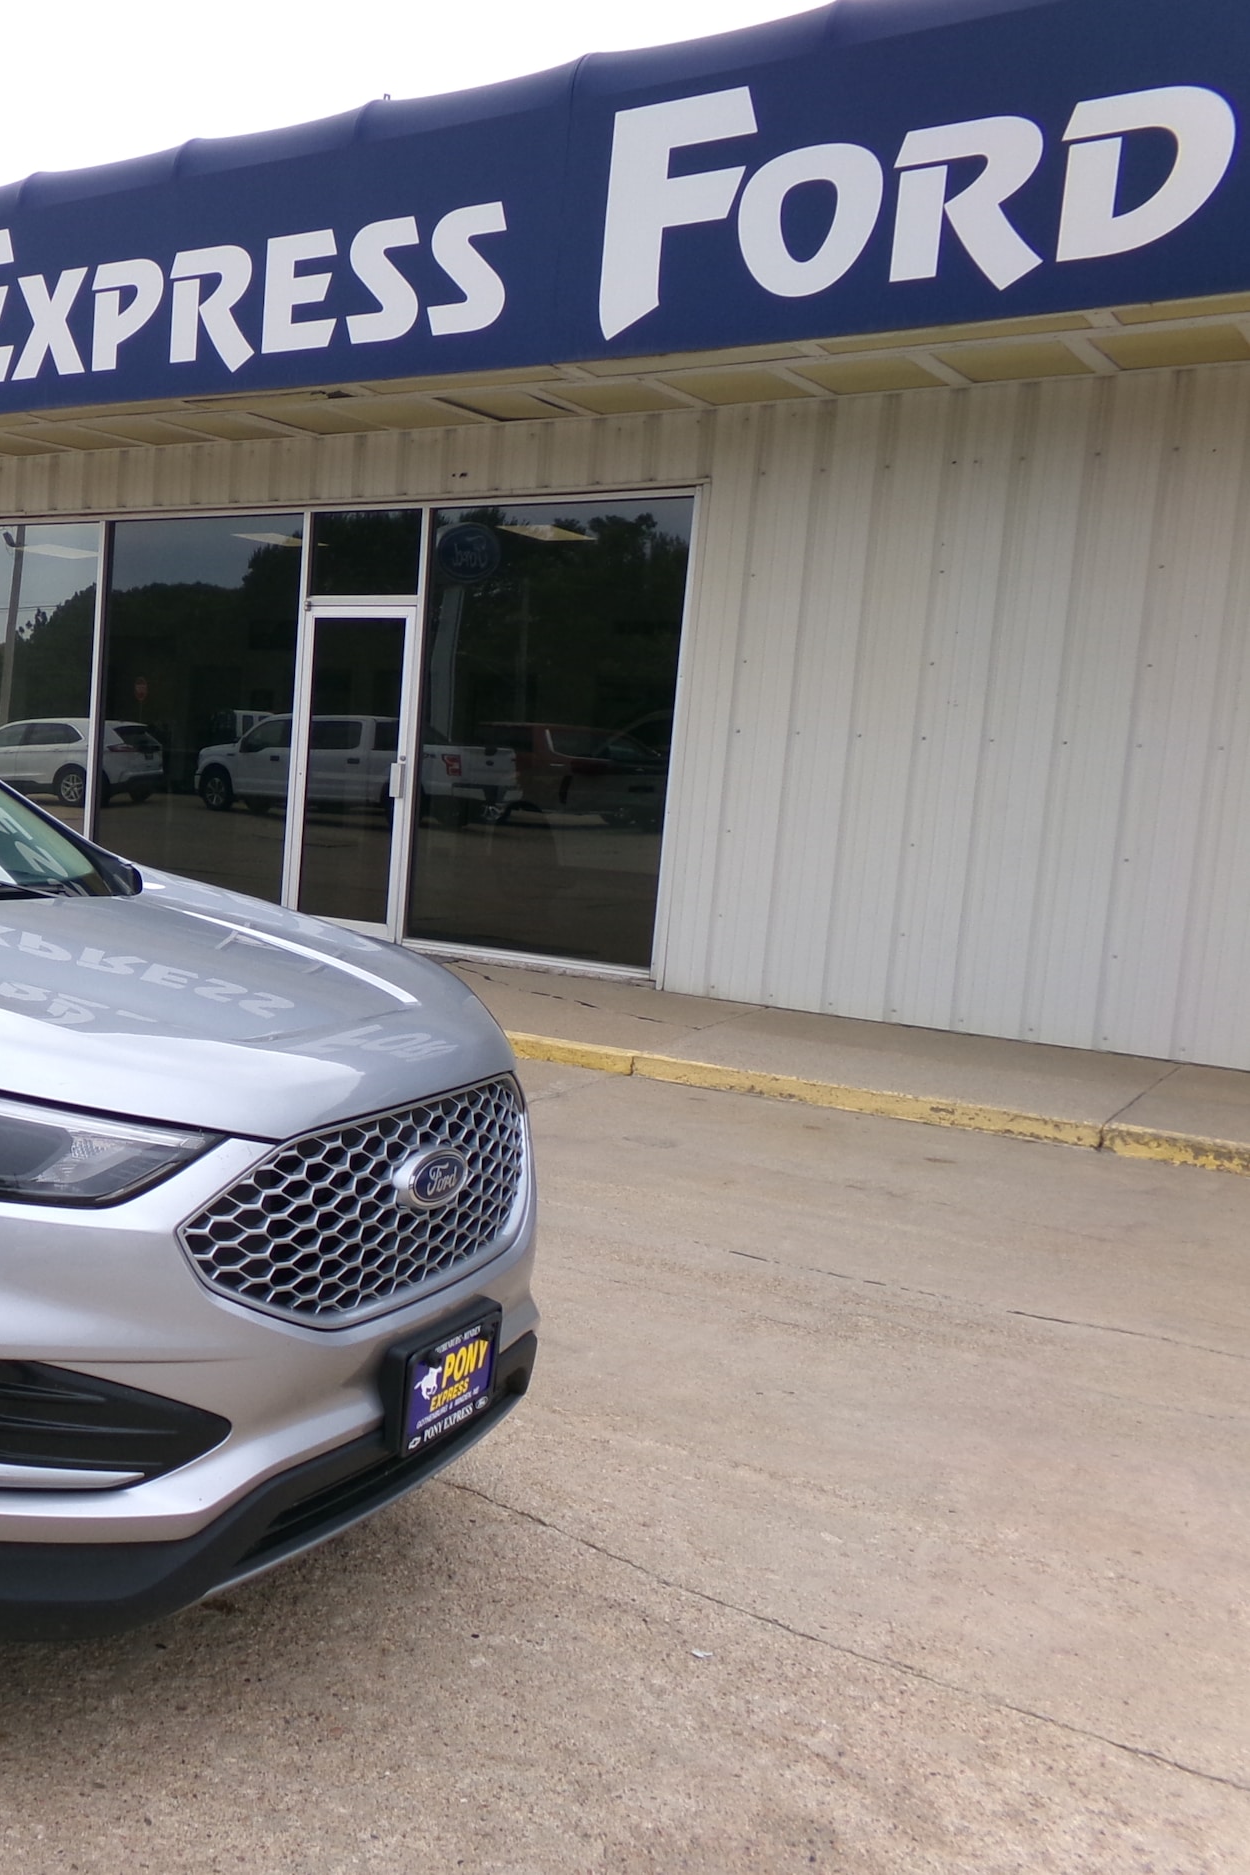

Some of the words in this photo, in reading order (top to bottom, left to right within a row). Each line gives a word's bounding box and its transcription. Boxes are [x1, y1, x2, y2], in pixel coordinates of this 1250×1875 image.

[598, 86, 1237, 341] FORD
[426, 1161, 458, 1196] Ford
[442, 1339, 489, 1389] PONY
[430, 1378, 470, 1412] EXPRESS
[424, 1420, 444, 1442] PONY
[443, 1402, 474, 1430] EXPRESS
